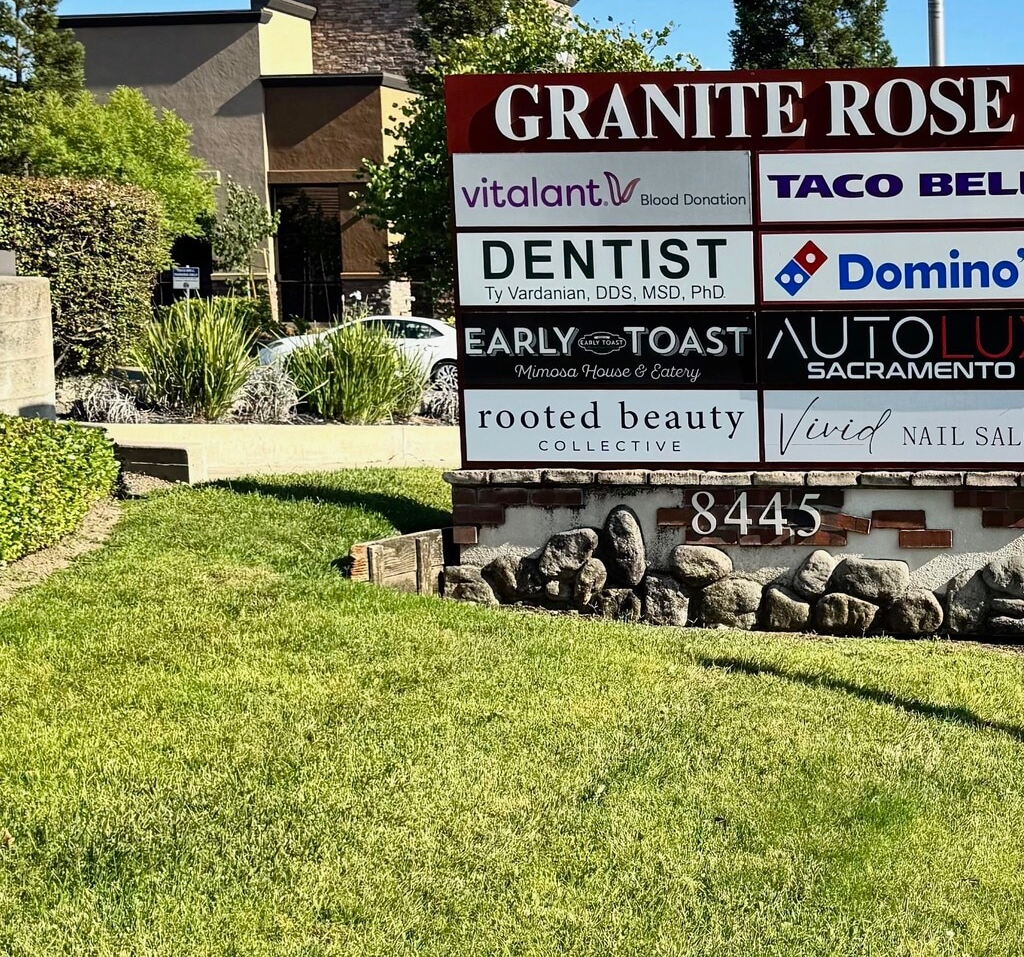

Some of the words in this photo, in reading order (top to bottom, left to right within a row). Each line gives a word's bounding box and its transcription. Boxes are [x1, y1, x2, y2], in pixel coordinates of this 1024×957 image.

[495, 82, 808, 142] GRANITE
[825, 76, 1016, 137] ROSE
[640, 194, 679, 206] Blood
[683, 193, 747, 206] Donation
[767, 173, 904, 199] TACO
[482, 238, 727, 280] DENTIST
[484, 286, 503, 304] Ty
[507, 284, 590, 301] Vardanian,
[596, 285, 637, 302] DDS,
[642, 284, 685, 302] MSD,
[464, 327, 579, 356] EARLY
[623, 326, 752, 356] TOAST
[514, 363, 579, 380] Mimosa
[581, 363, 632, 379] House
[634, 363, 647, 377] &
[650, 363, 701, 382] Eatery
[807, 361, 1016, 380] SACRAMENTO
[477, 400, 601, 430] rooted
[618, 401, 745, 439] beauty
[780, 396, 892, 456] Vivid
[902, 426, 965, 446] NAIL
[538, 440, 681, 452] COLLECTIVE
[690, 490, 822, 538] 8445
